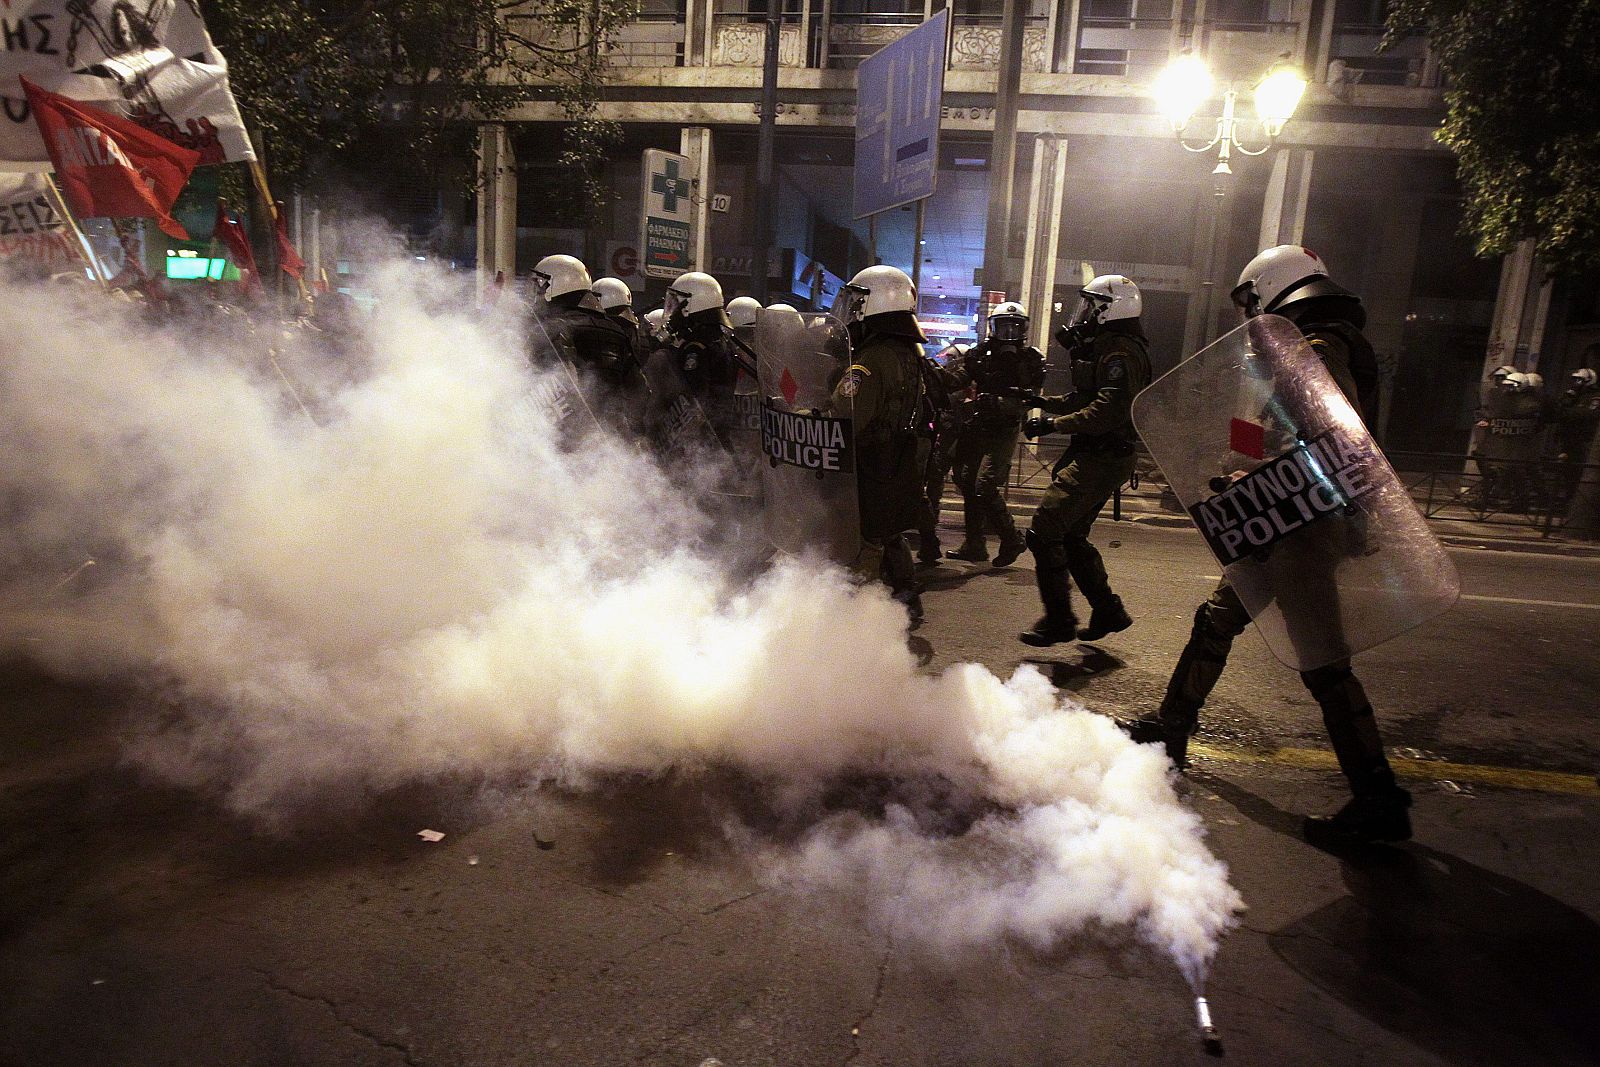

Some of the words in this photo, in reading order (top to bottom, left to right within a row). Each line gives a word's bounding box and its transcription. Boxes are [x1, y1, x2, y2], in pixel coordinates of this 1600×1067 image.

[714, 197, 727, 211] 10
[649, 236, 688, 252] PHARMACY
[764, 433, 841, 471] POLICE
[1199, 431, 1362, 537] ΑΣΤΥΝΟΜΙΑ
[1219, 462, 1374, 559] POLICE
